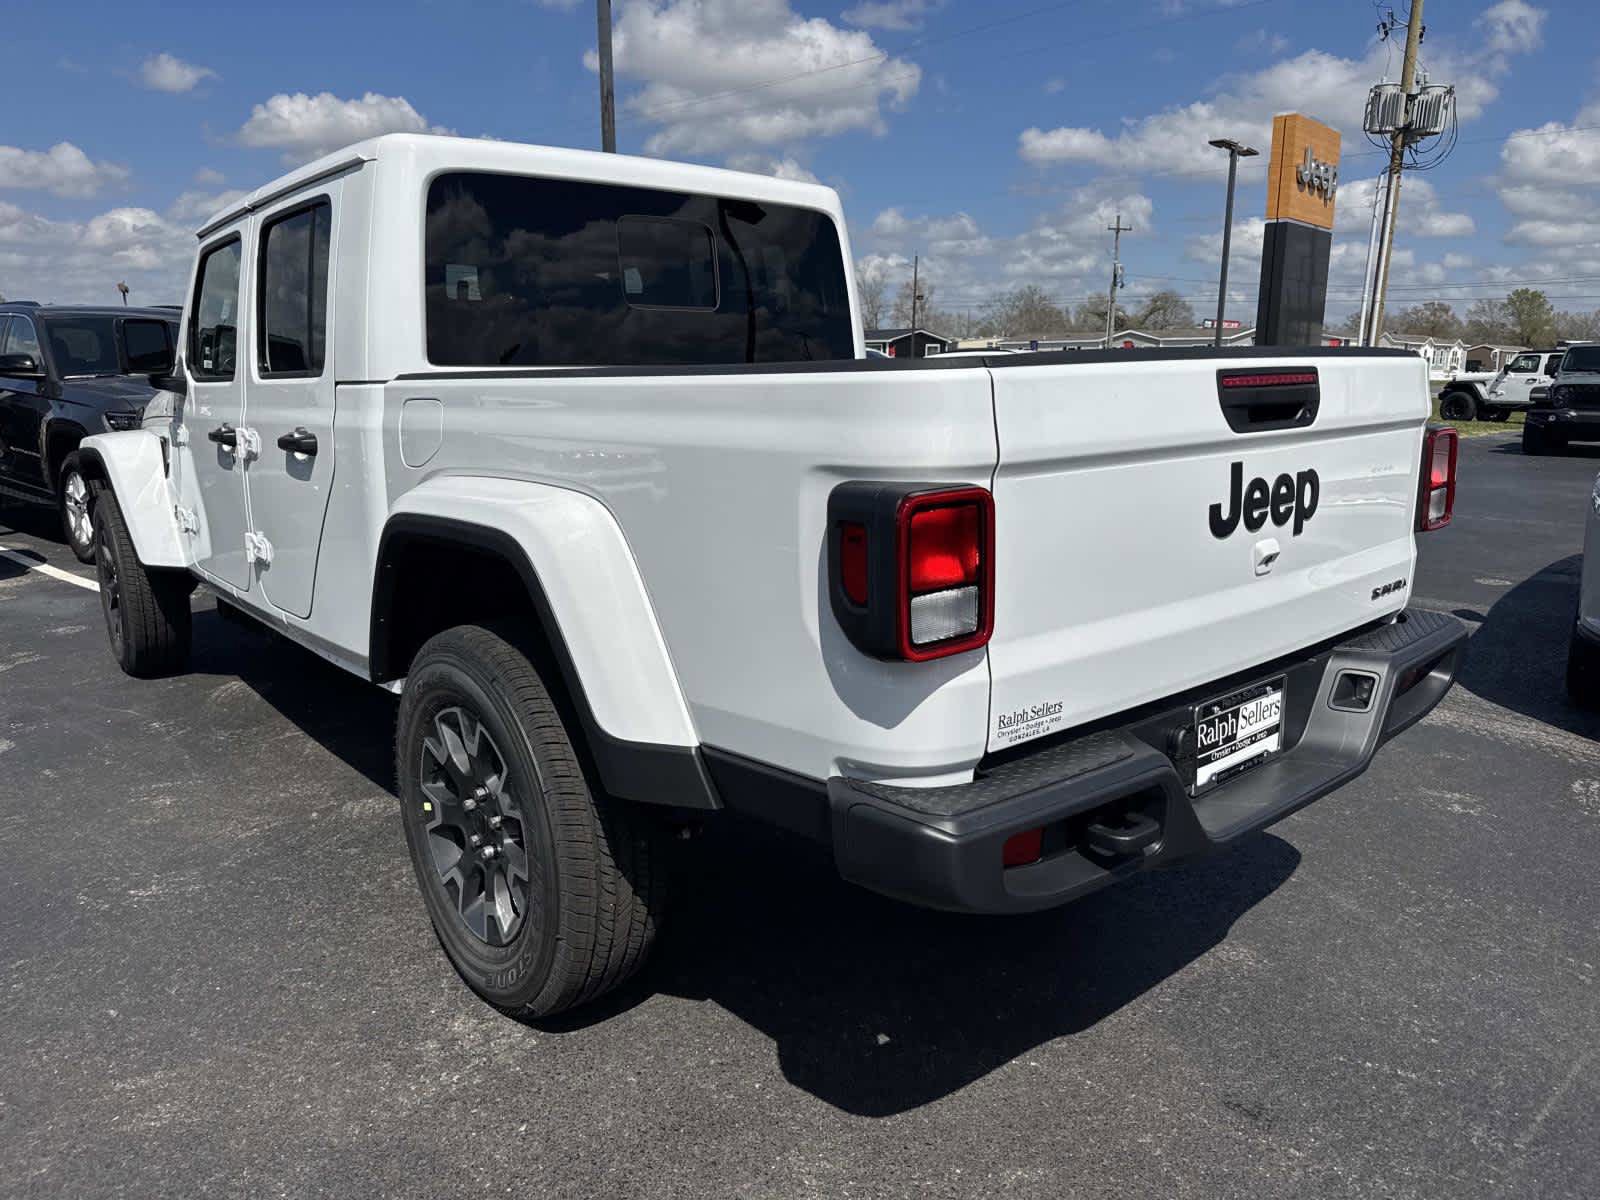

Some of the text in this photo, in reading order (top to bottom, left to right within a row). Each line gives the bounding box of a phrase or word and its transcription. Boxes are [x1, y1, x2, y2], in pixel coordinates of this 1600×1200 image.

[1296, 146, 1336, 199] Jeep
[1209, 461, 1319, 540] Jeep
[998, 702, 1063, 728] Ralph Sellers
[998, 728, 1021, 738] Chrysler
[1026, 720, 1044, 730] Dodge
[1198, 700, 1280, 748] Ralph Sellers
[1211, 745, 1232, 761] Chrysler
[1236, 737, 1252, 750] Dodge
